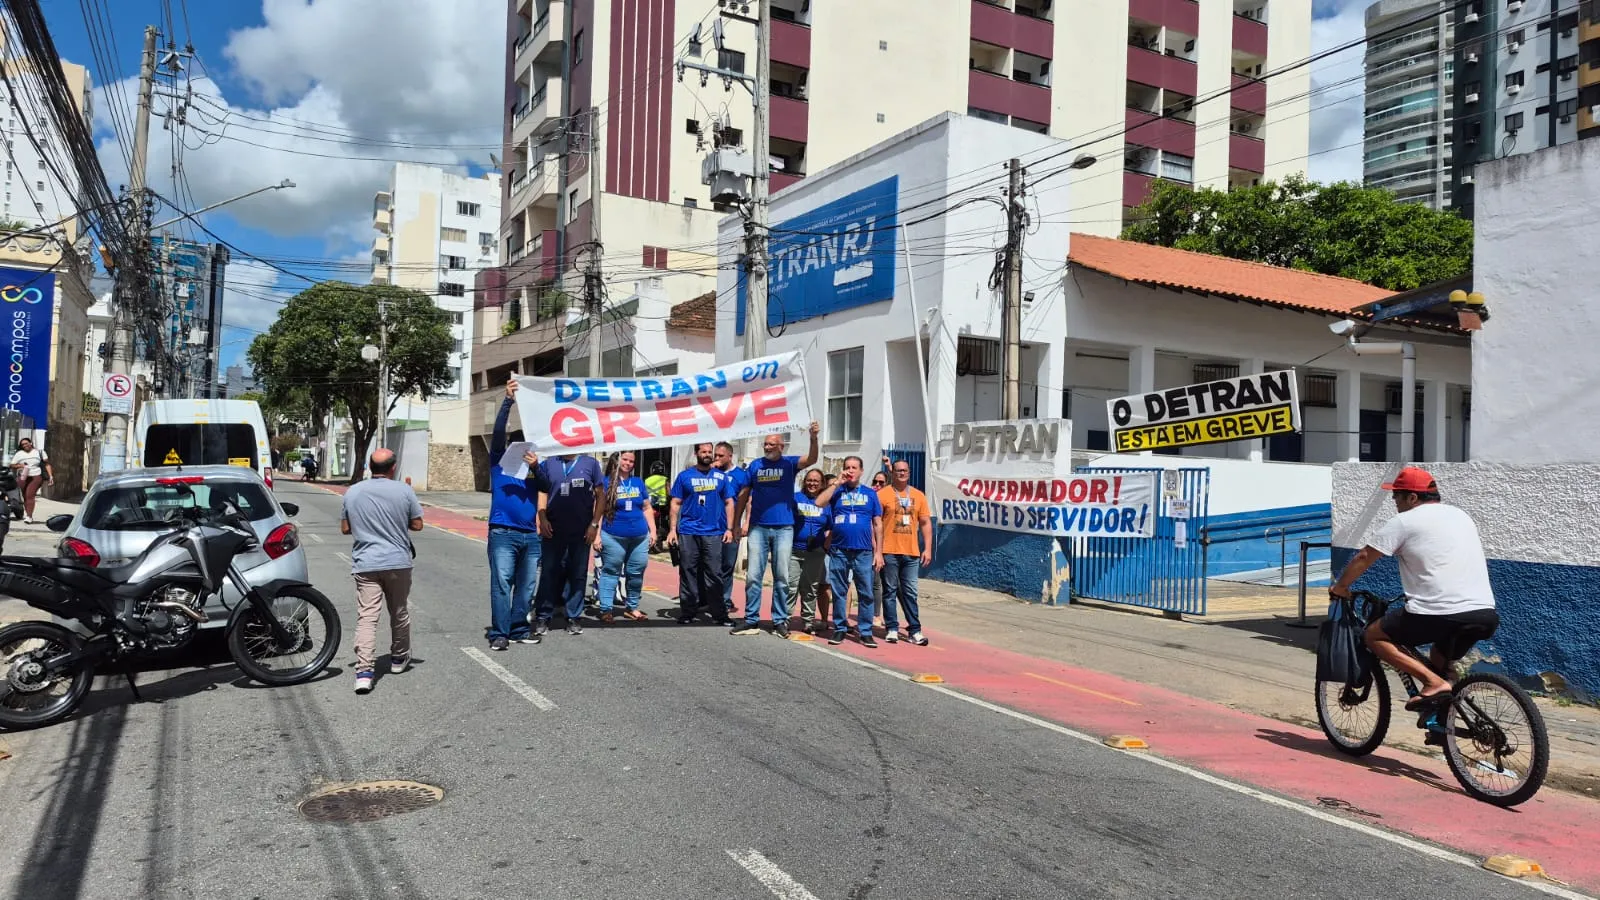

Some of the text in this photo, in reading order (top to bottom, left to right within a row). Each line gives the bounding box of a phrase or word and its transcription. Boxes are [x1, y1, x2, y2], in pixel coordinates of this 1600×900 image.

[554, 360, 780, 403] DETRAN em
[1113, 372, 1291, 426] O DETRAN
[549, 385, 790, 448] GREVE
[1118, 410, 1287, 450] ESTÁ EM GREVE
[952, 422, 1059, 455] DETRAN
[957, 476, 1122, 506] GOVERNADOR!
[942, 499, 1009, 527] RESPEITE
[1028, 503, 1149, 534] SERVIDOR!
